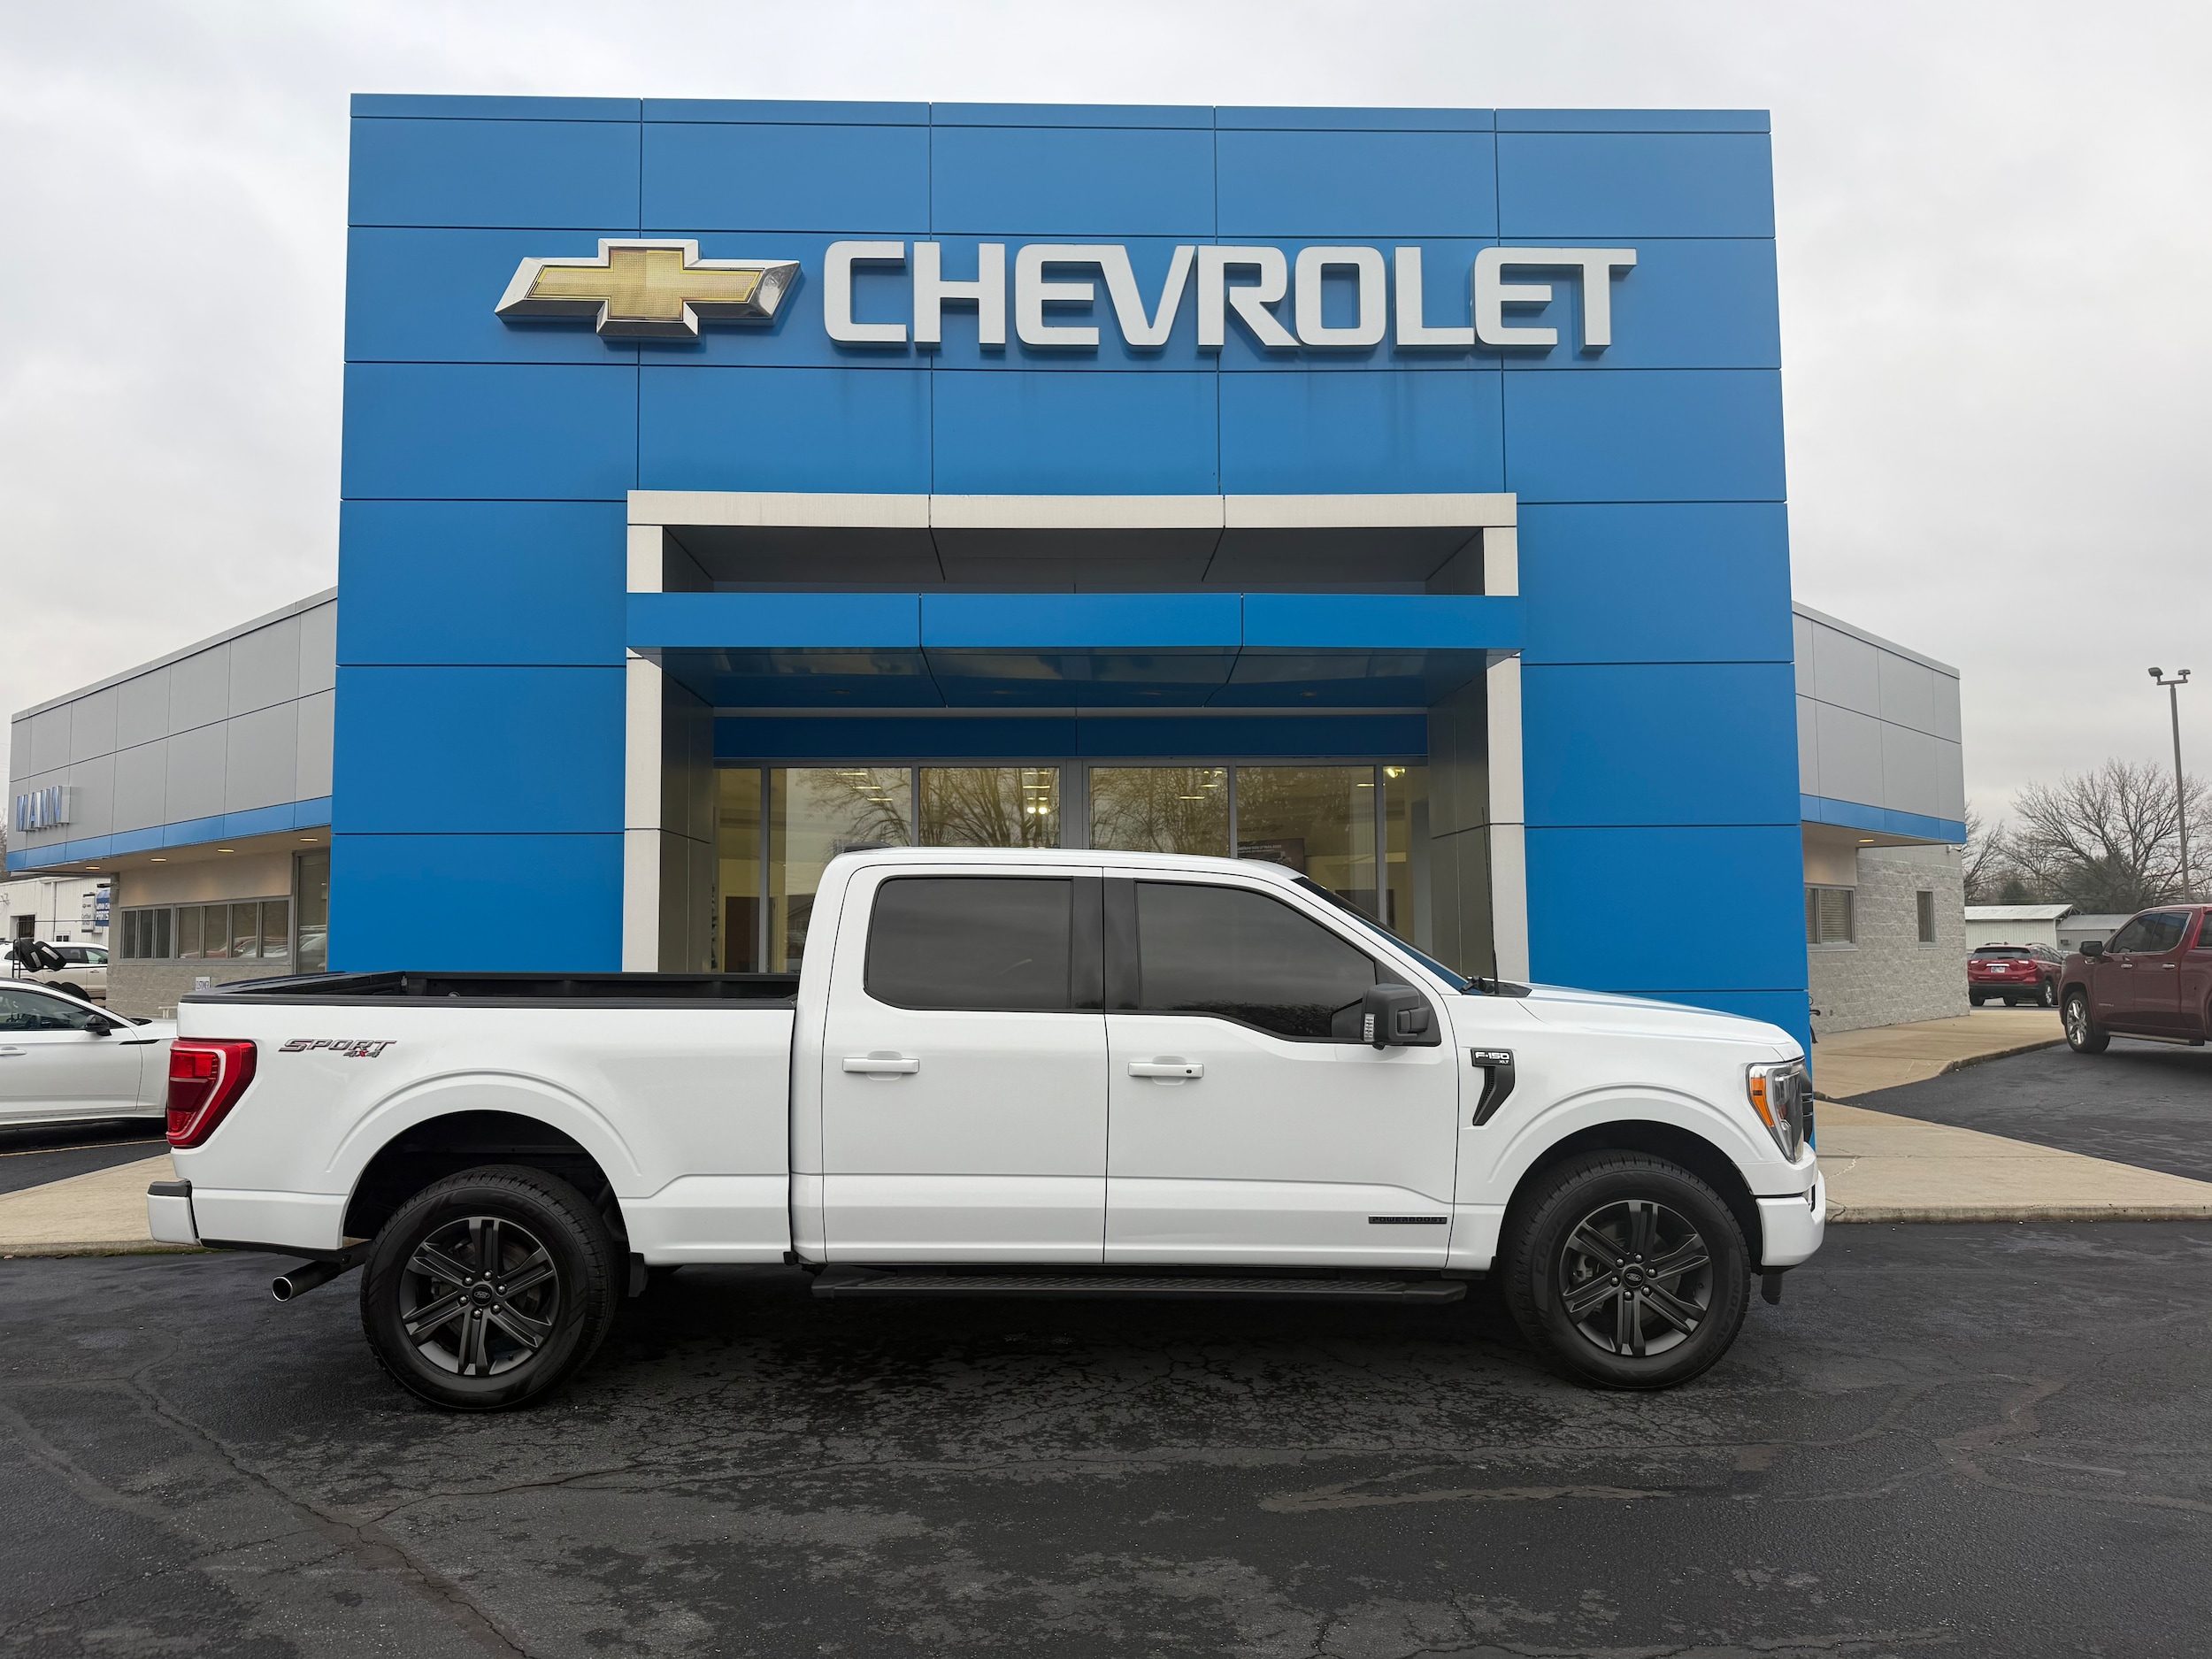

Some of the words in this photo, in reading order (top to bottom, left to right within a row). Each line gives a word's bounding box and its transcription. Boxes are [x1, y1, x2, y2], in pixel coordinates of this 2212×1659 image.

[824, 240, 1637, 349] CHEVROLET
[16, 786, 65, 832] MANN
[278, 1039, 397, 1052] SPORT
[1475, 1051, 1510, 1060] F-150
